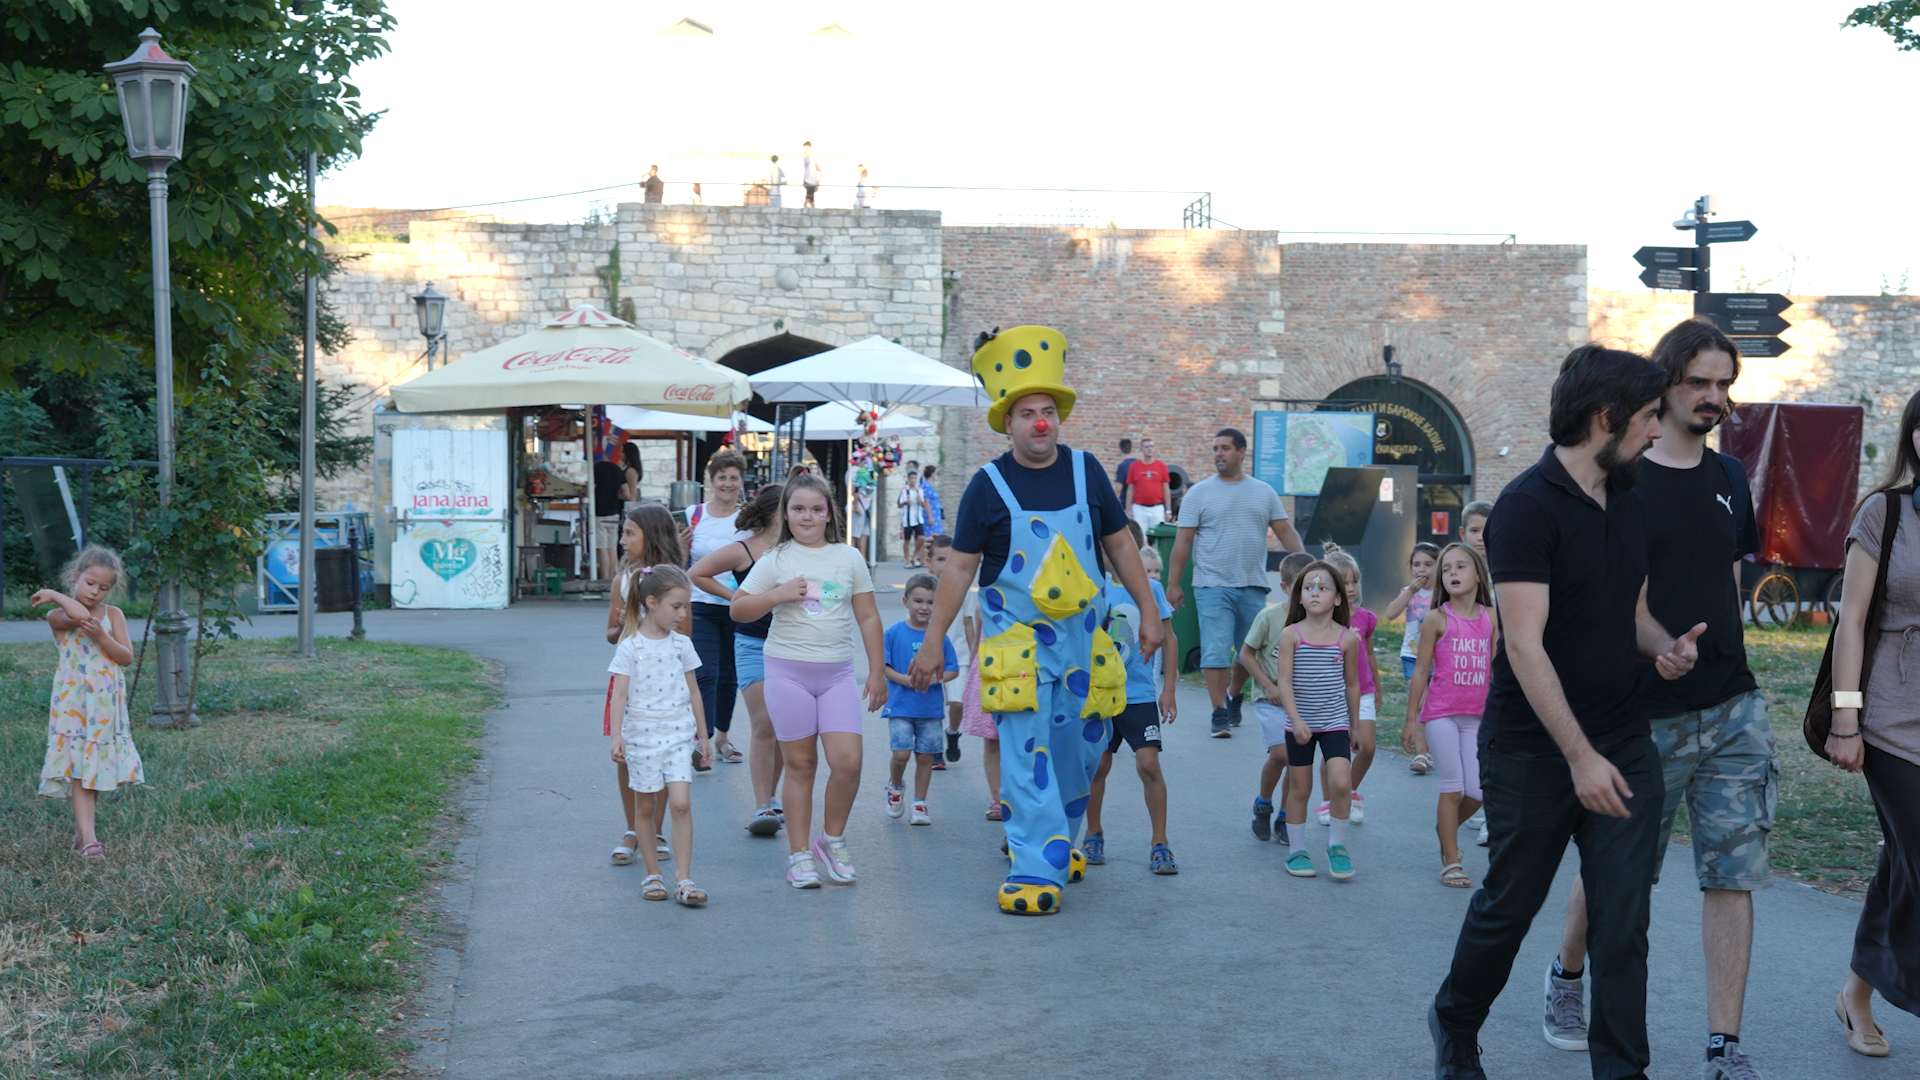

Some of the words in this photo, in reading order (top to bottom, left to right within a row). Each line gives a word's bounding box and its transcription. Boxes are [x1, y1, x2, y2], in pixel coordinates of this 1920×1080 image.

[502, 347, 640, 370] Coca-Cola
[663, 384, 717, 401] Coca-Cola
[432, 542, 469, 567] Mg
[1452, 637, 1476, 652] TAKE
[1454, 655, 1468, 669] TO
[1471, 655, 1486, 669] THE
[1454, 671, 1486, 686] OCEAN
